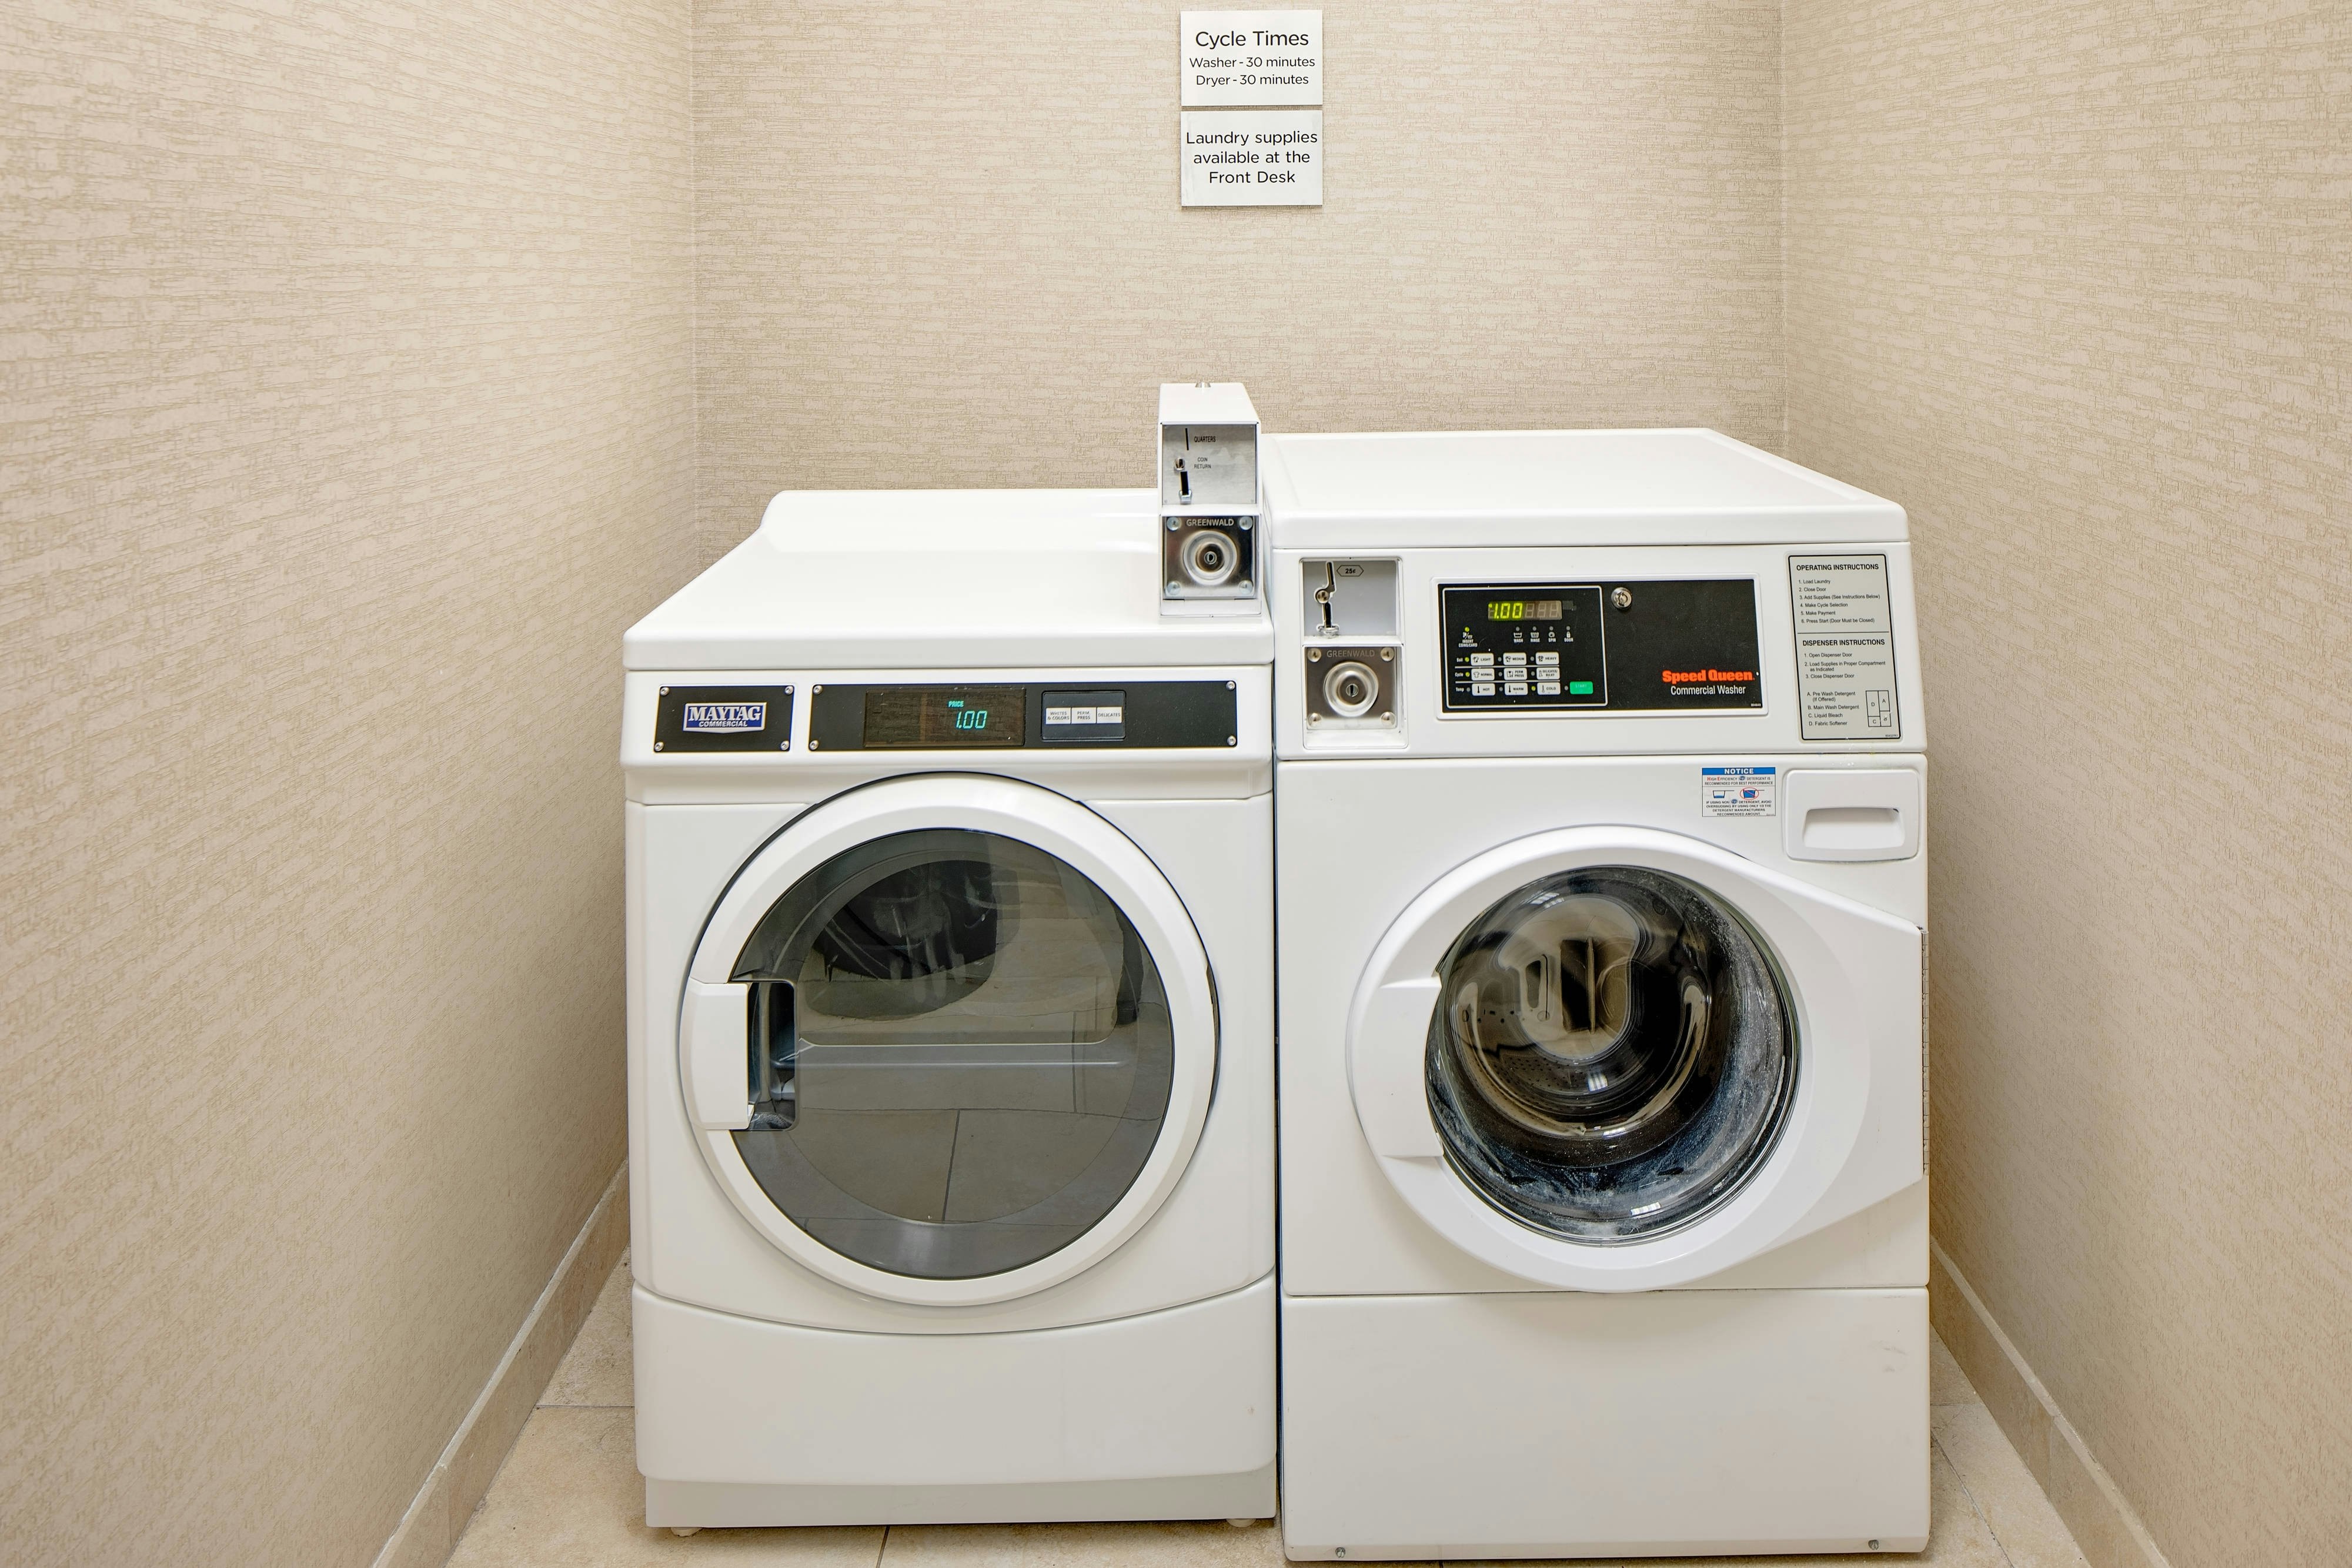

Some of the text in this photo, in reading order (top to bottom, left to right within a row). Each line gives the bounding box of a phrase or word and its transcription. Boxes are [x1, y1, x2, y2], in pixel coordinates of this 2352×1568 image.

[1195, 31, 1309, 49] Cycle Times
[1190, 58, 1237, 68] Washer
[1246, 57, 1262, 67] 30
[1266, 57, 1315, 67] minutes
[1197, 75, 1230, 87] Dryer
[1240, 75, 1256, 85] 30
[1260, 74, 1309, 85] minutes
[1187, 131, 1318, 146] Laundry supplies
[1194, 151, 1310, 163] available at the
[1210, 170, 1295, 183] Front Desk
[1662, 669, 1753, 684] Speed Queen
[1671, 686, 1746, 695] Commercial Washer
[688, 707, 760, 721] MAYTAG
[956, 711, 987, 728] 1.00
